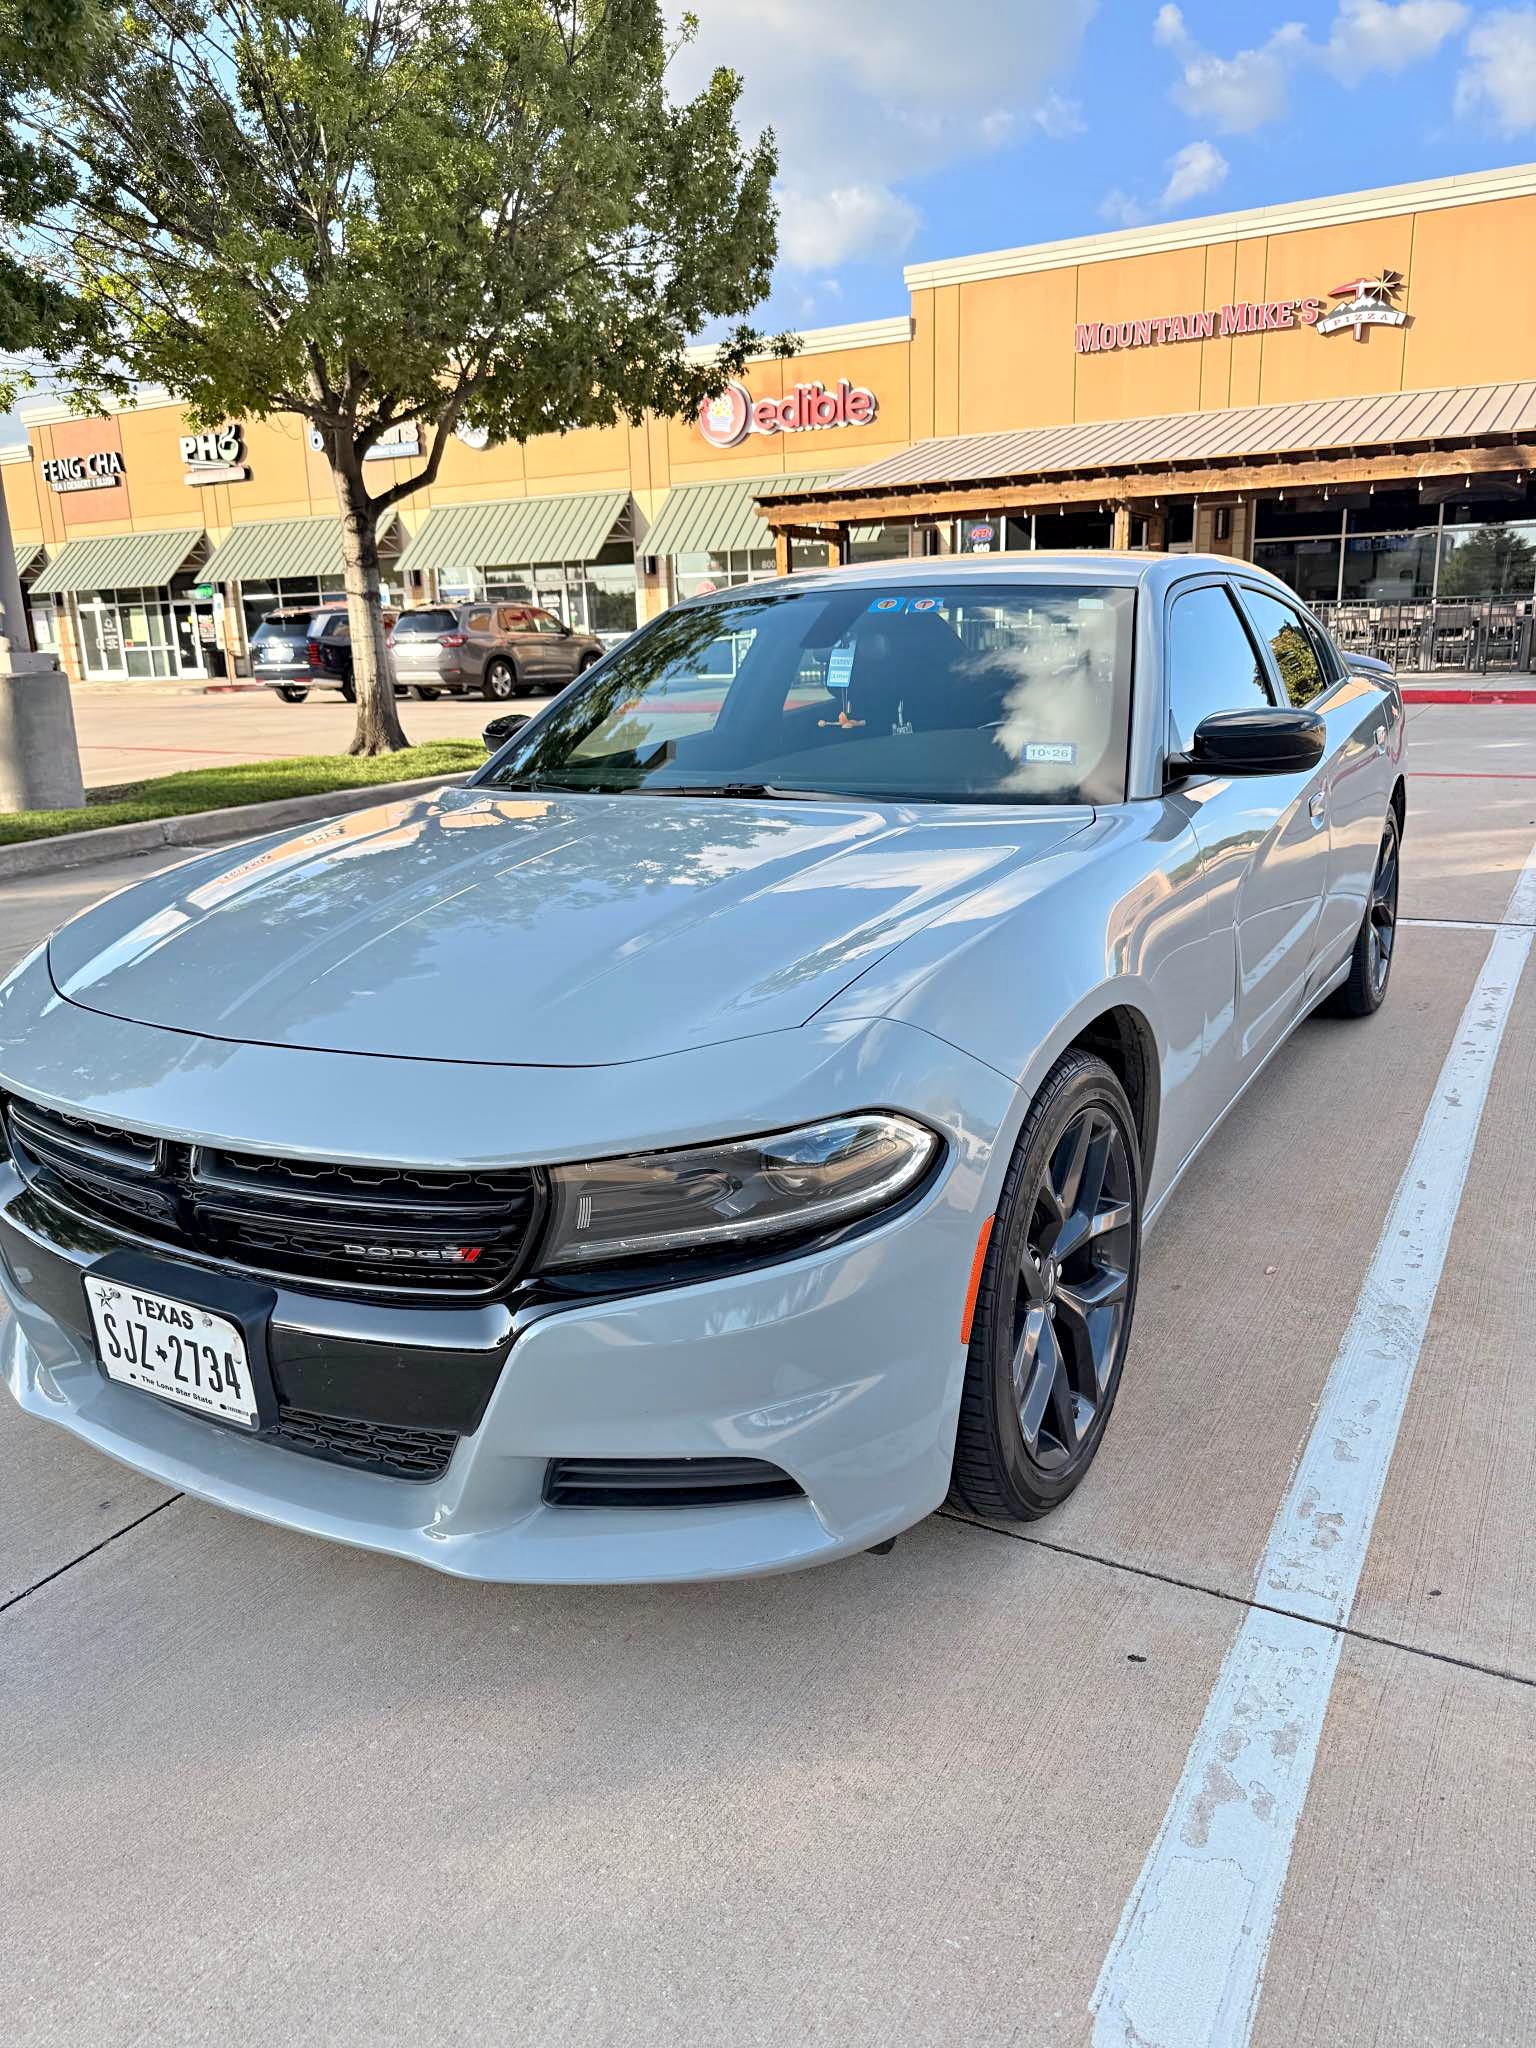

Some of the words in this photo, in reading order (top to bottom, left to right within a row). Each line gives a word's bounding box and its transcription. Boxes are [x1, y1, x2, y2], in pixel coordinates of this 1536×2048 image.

[1075, 310, 1214, 353] MOUNTAIN
[1220, 297, 1319, 336] MIKE'S
[1333, 313, 1388, 326] PIZZA
[753, 379, 873, 433] edible
[41, 456, 81, 481] FENG
[86, 451, 121, 476] CHA
[971, 528, 993, 539] OPEN
[344, 1244, 464, 1259] DODGE
[131, 1295, 194, 1330] TEXAS
[141, 1375, 155, 1386] The
[156, 1380, 174, 1393] Lone
[175, 1386, 191, 1398] Star
[192, 1392, 213, 1405] State
